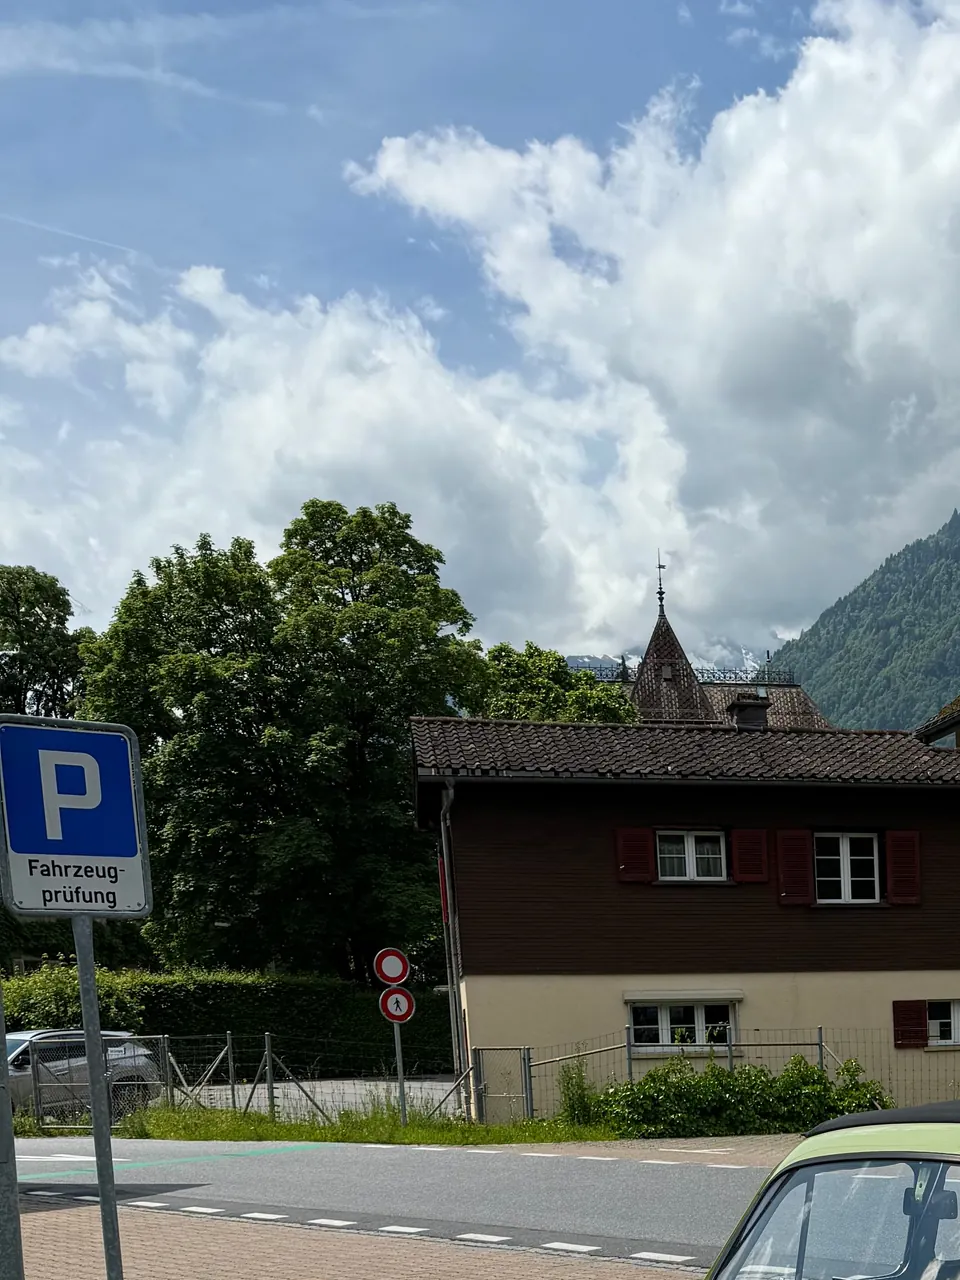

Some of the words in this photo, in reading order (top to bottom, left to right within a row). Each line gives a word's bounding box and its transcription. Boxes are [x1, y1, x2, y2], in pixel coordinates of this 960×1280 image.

[38, 750, 102, 840] P
[28, 859, 125, 883] Fahrzeug-
[42, 886, 117, 908] prüfung
